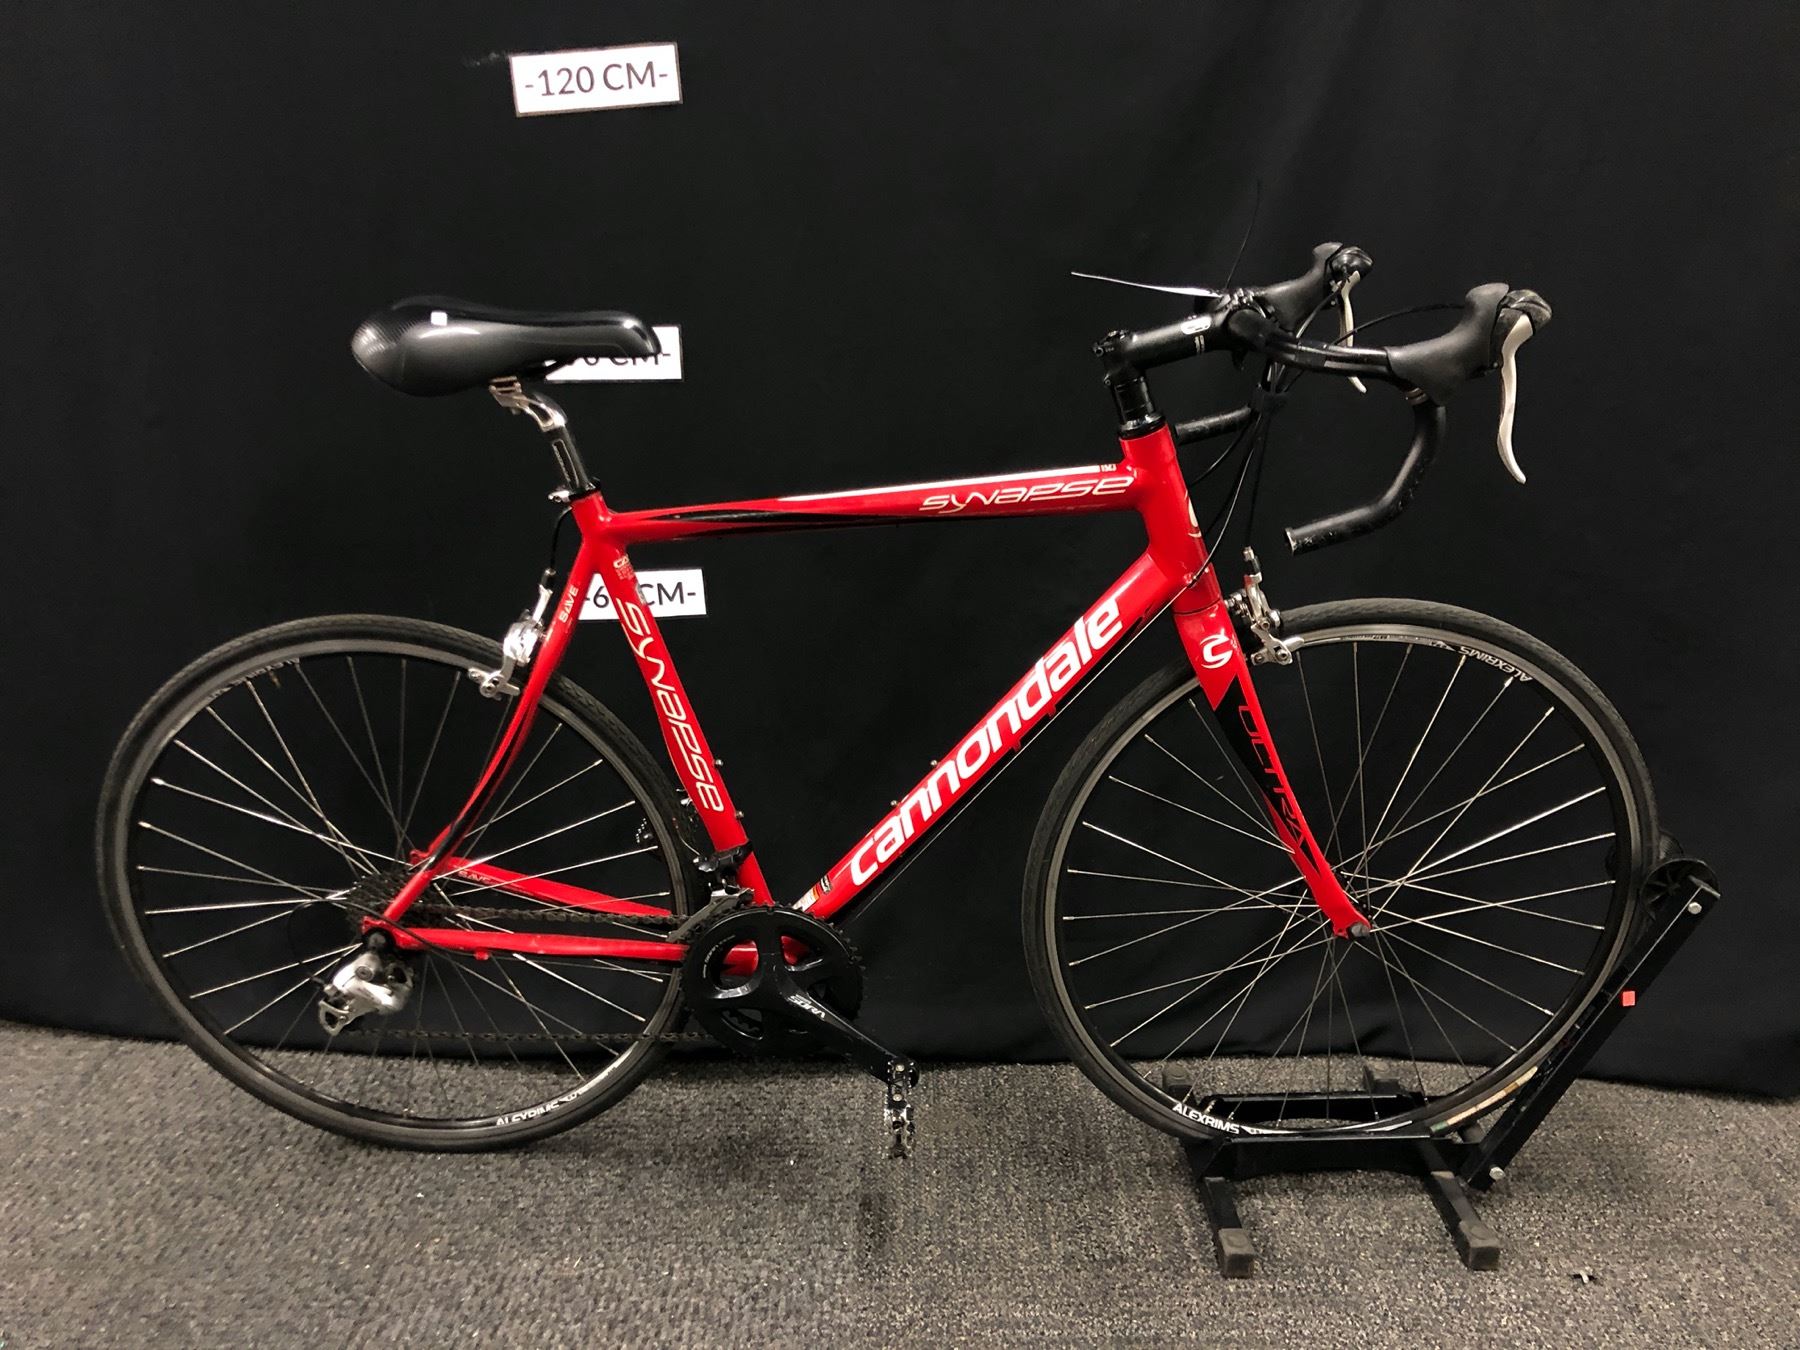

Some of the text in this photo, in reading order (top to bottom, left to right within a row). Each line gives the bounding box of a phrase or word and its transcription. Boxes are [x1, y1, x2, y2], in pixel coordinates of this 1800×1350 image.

[525, 61, 668, 97] -120 CM-
[1457, 645, 1534, 683] ALEXRIMS
[849, 595, 1124, 887] cannondale
[1172, 1101, 1241, 1136] ALEXRIMS
